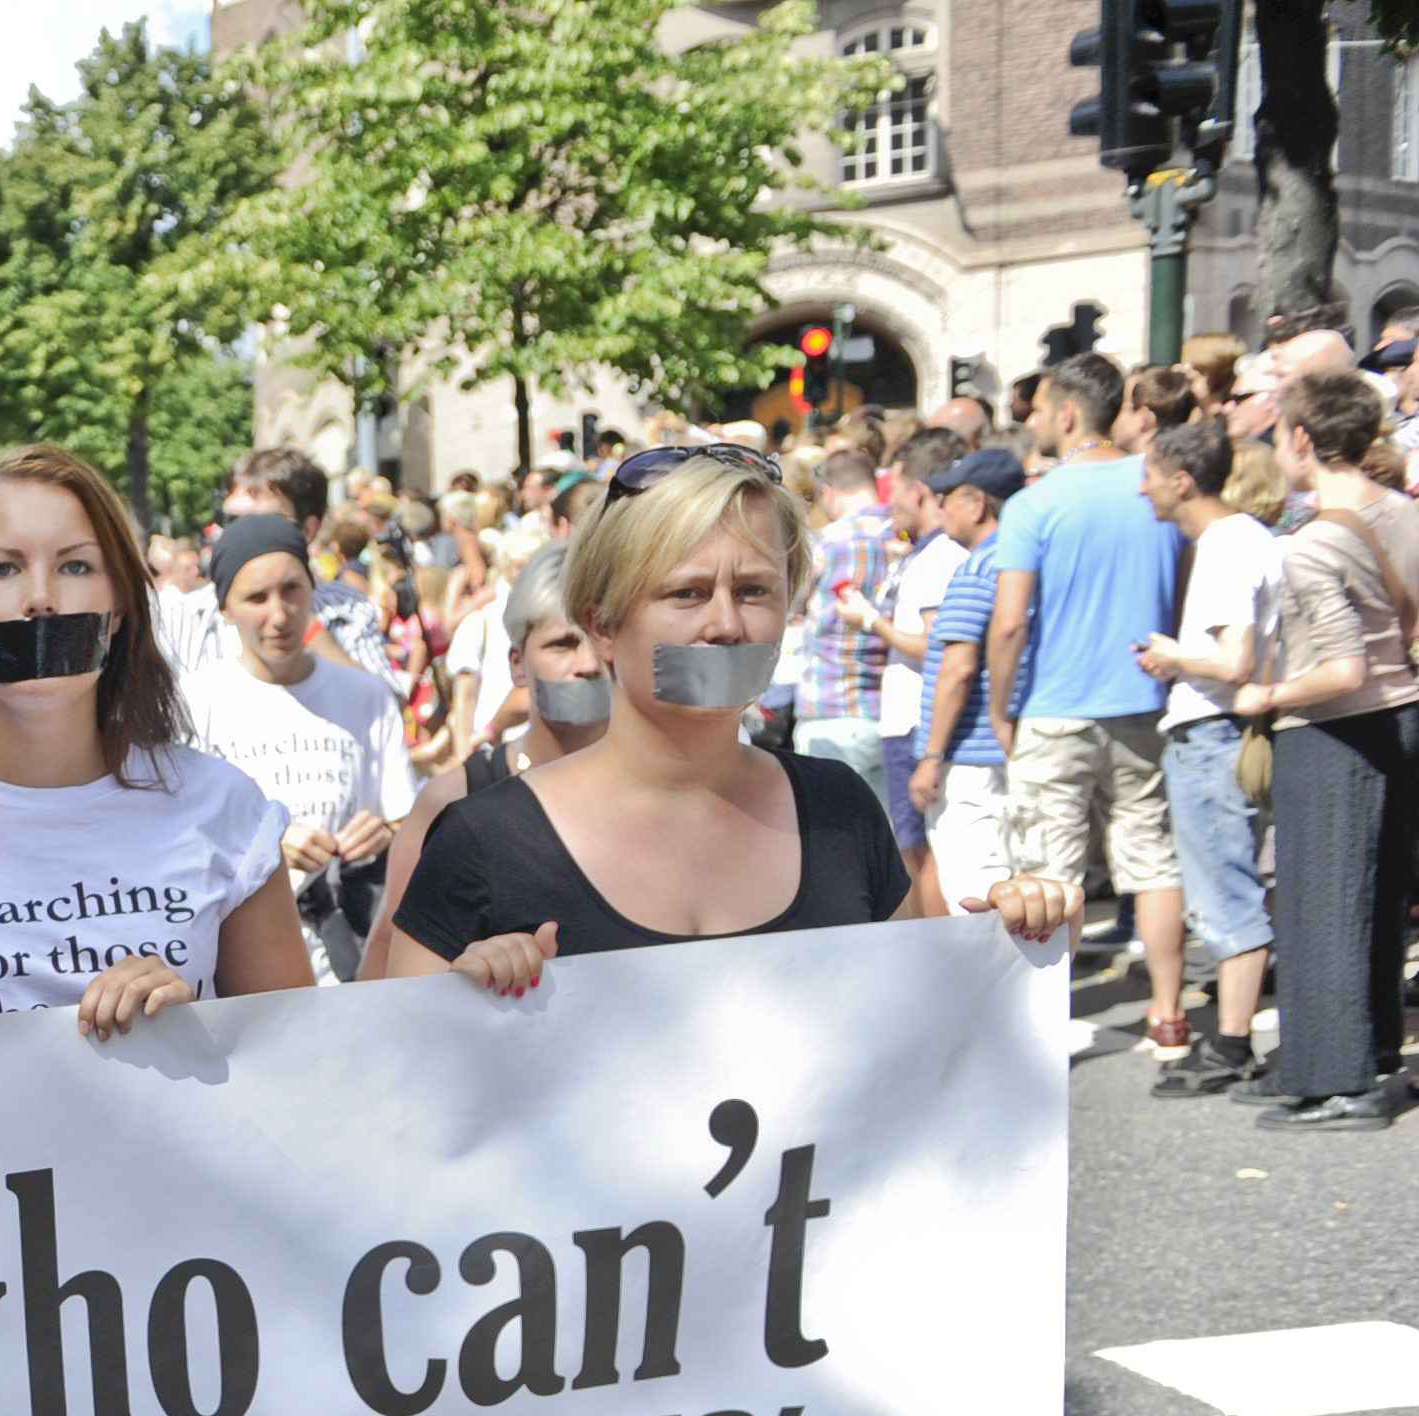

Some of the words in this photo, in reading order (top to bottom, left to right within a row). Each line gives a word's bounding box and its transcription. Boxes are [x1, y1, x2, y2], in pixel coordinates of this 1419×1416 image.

[212, 733, 355, 760] Marching
[275, 765, 350, 785] those
[47, 935, 189, 974] those
